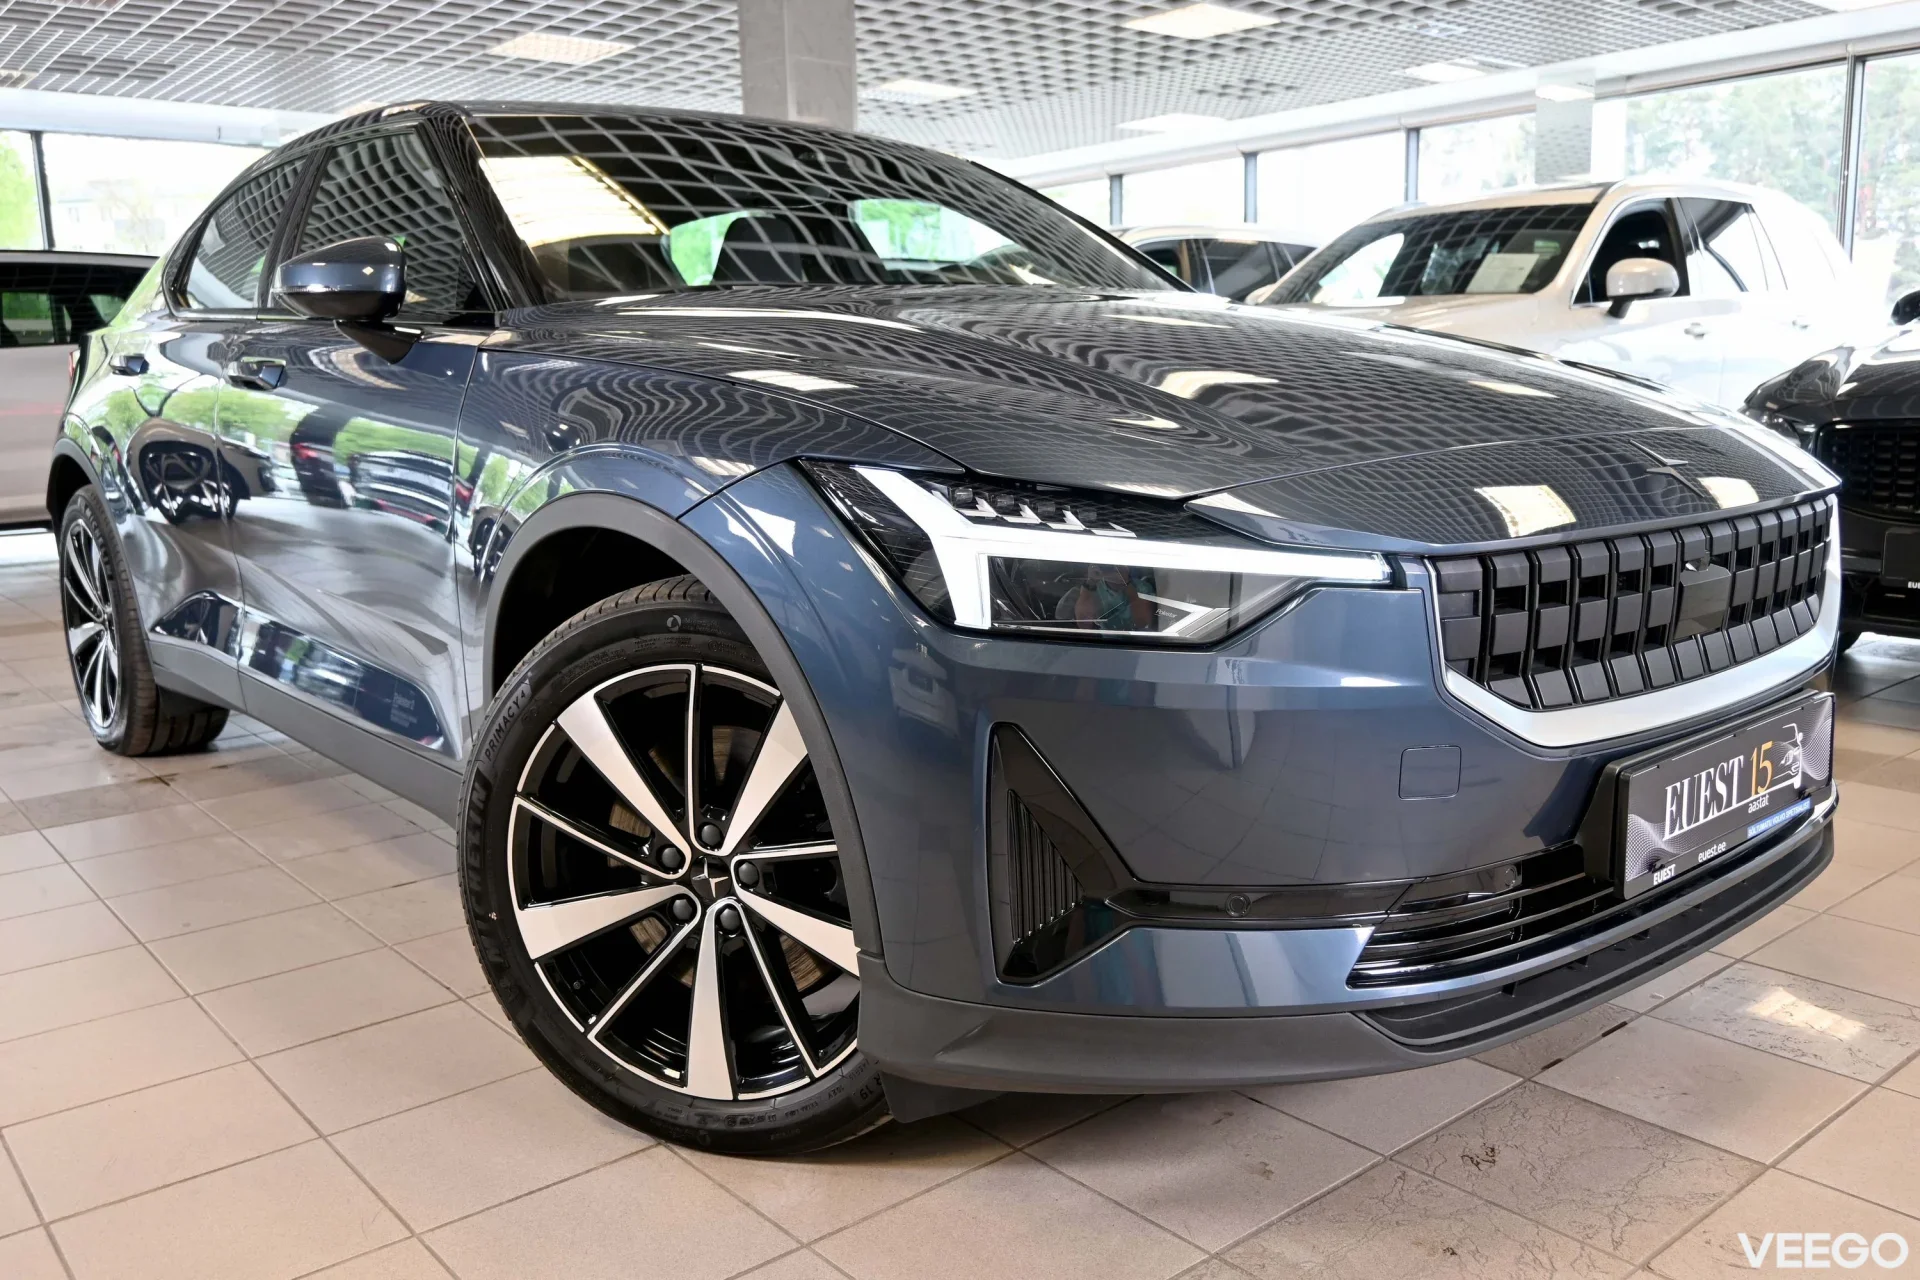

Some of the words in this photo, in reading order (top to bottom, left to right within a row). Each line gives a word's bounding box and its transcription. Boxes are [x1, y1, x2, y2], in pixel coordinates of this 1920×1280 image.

[484, 696, 521, 761] PRIMACY
[1662, 754, 1744, 841] EUEST
[1750, 741, 1774, 798] 15
[1747, 794, 1770, 813] aastat
[1697, 841, 1727, 863] euest.ee
[1653, 863, 1676, 886] EUEST
[859, 1085, 875, 1100] 19
